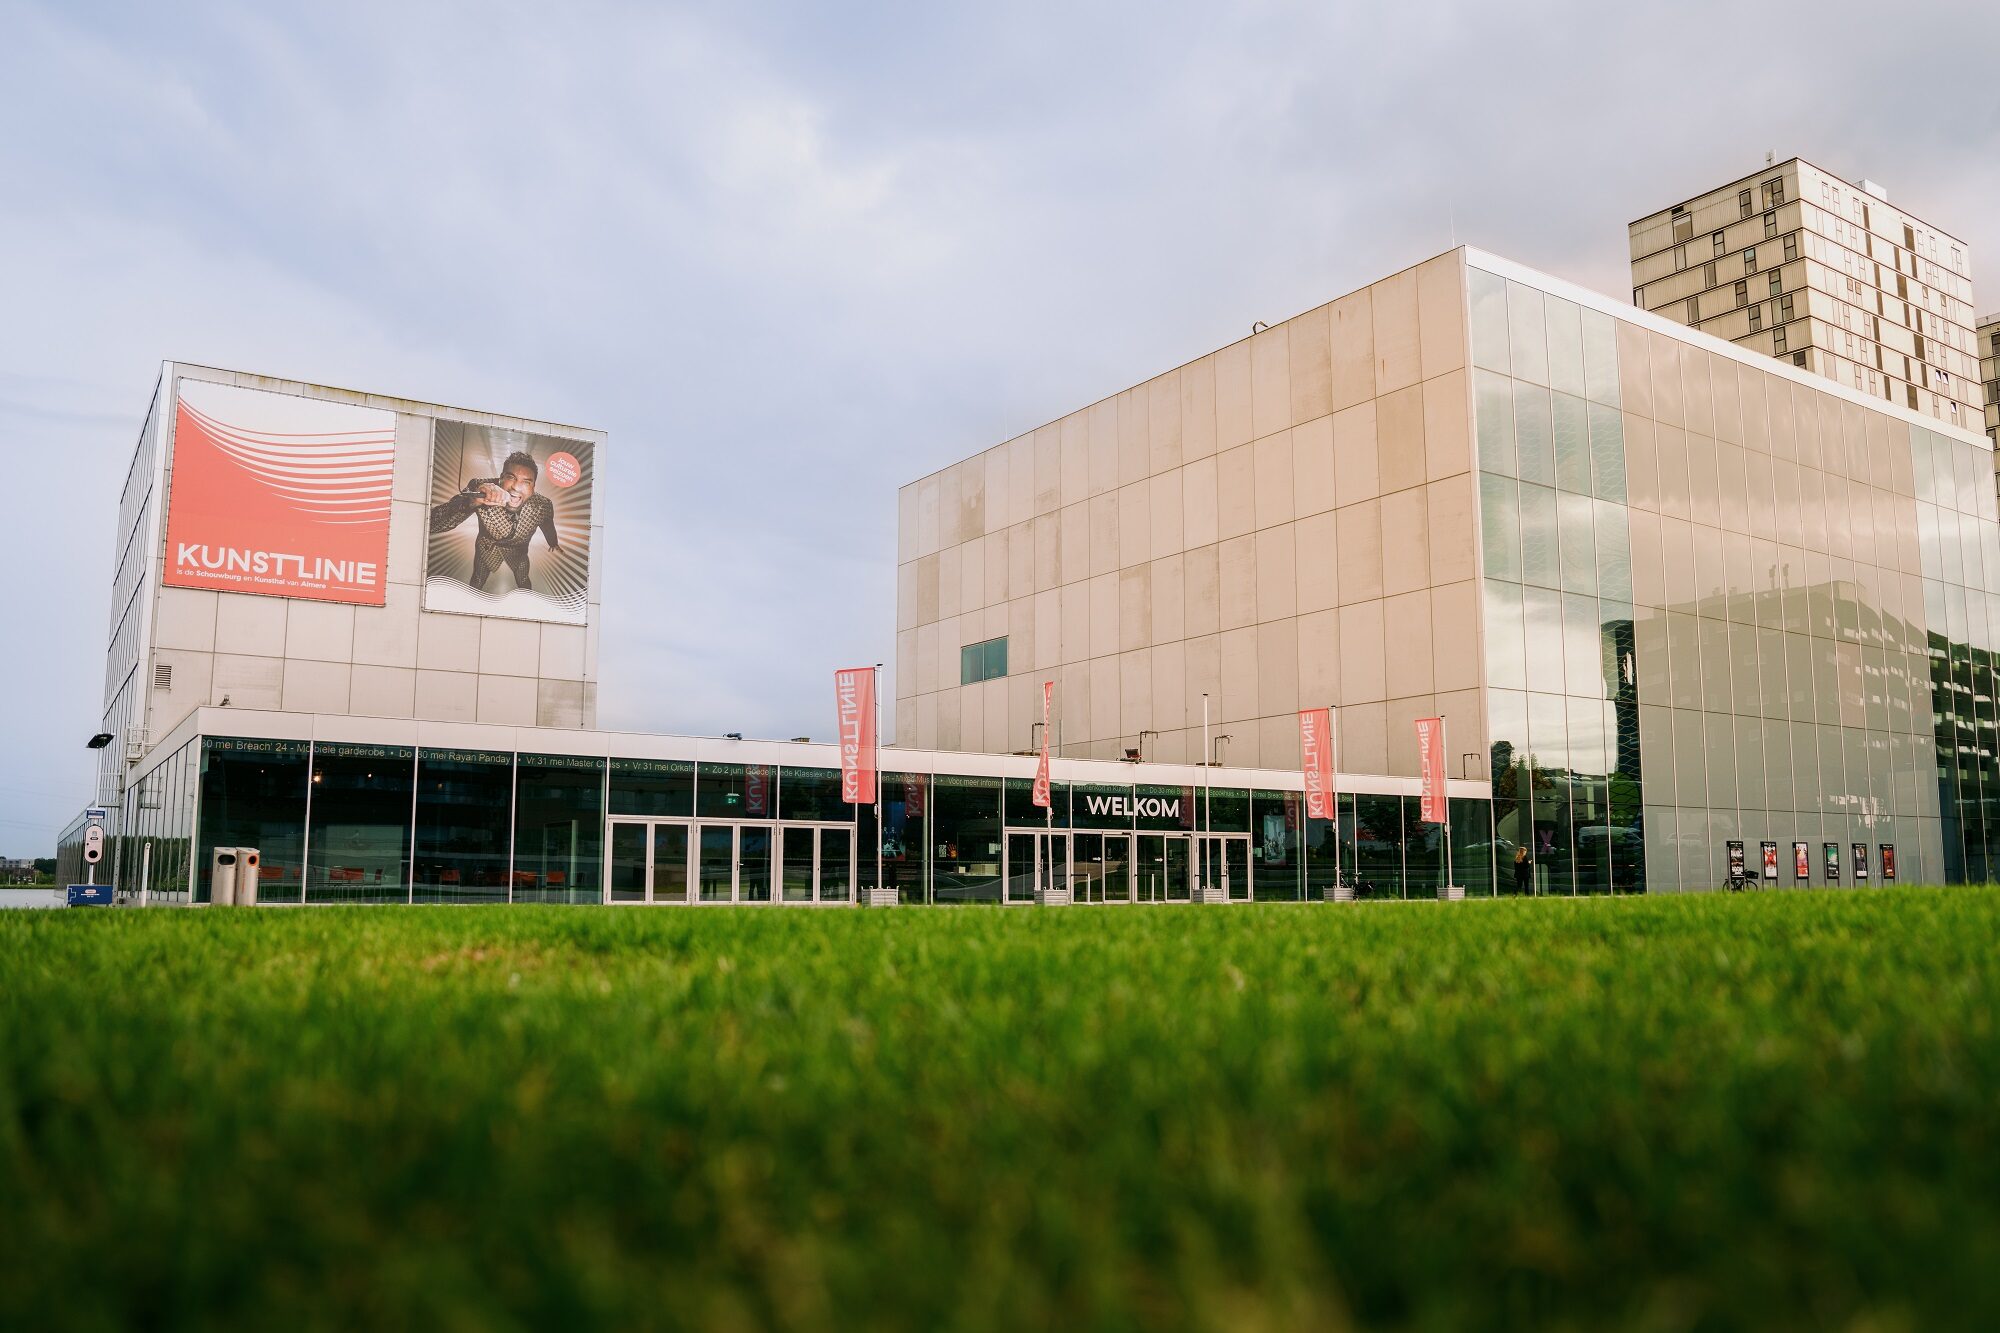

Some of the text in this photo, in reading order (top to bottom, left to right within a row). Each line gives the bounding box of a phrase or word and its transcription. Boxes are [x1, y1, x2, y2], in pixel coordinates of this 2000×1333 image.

[177, 543, 377, 585] KUNSTLINIE
[196, 570, 241, 582] Schouwburg
[254, 576, 285, 585] Kunsthal
[301, 581, 327, 589] Almere
[215, 740, 233, 749] mei
[338, 746, 384, 757] garderobe
[400, 750, 412, 758] Do
[430, 752, 446, 760] mei
[449, 752, 477, 762] Rayan
[479, 754, 510, 765] Panday
[538, 757, 547, 765] 31
[550, 758, 565, 766] mei
[567, 758, 593, 768] Master
[633, 762, 641, 770] Vr
[643, 762, 652, 770] 31
[730, 766, 744, 776] juni
[1086, 796, 1179, 818] WELKOM
